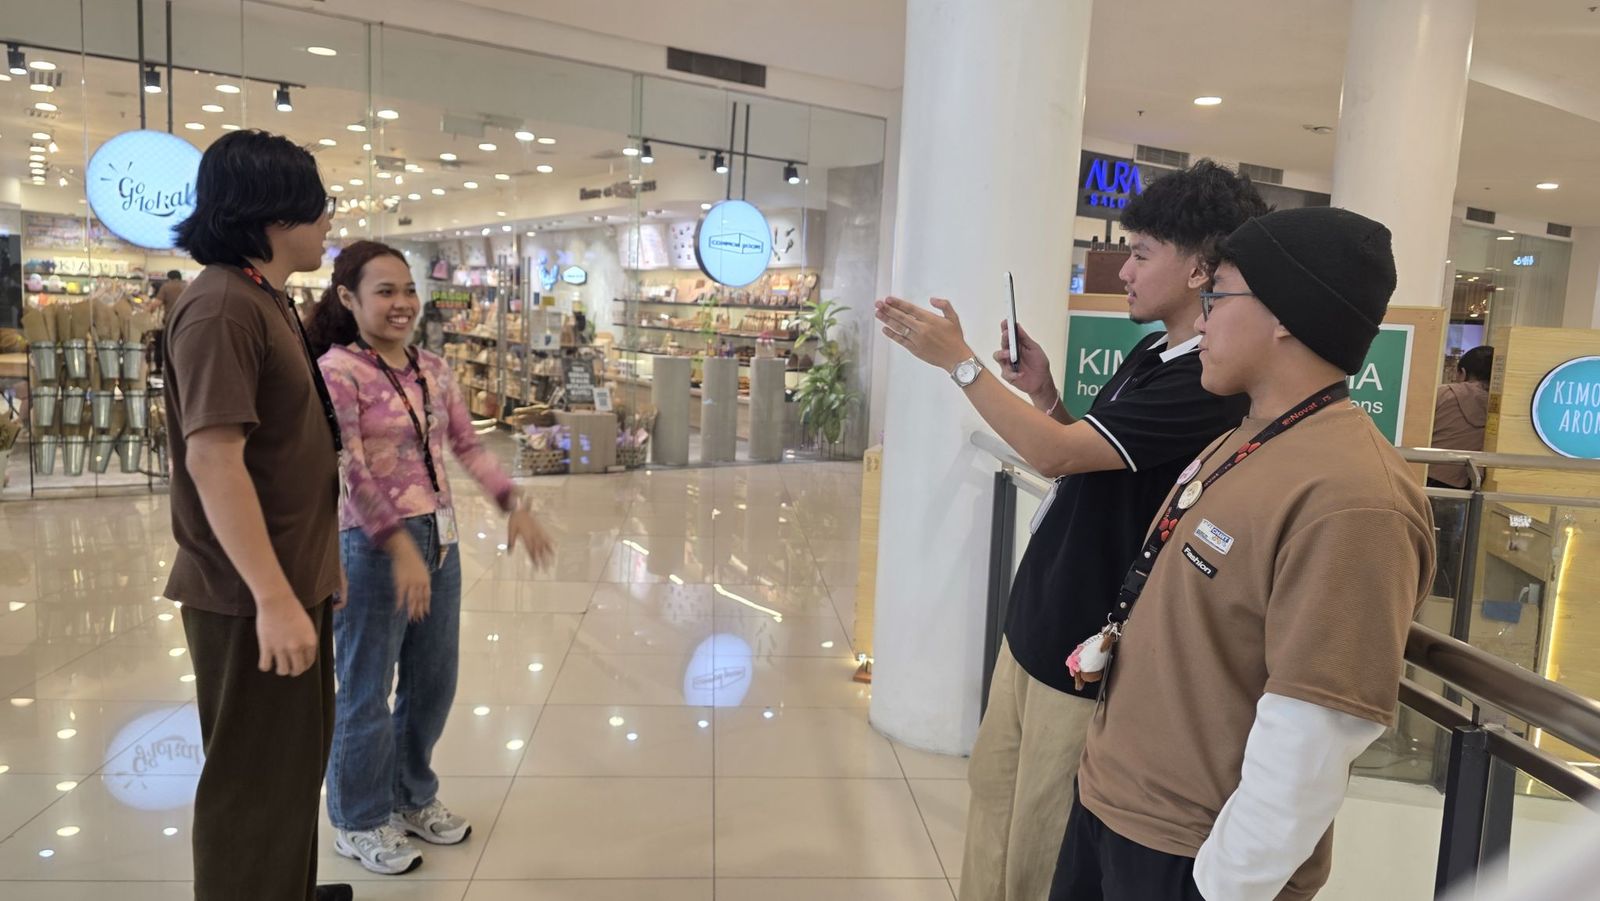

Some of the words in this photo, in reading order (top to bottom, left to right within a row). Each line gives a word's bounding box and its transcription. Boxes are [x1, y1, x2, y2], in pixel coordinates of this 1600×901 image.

[1085, 158, 1143, 196] AURA
[118, 177, 146, 211] Go
[1089, 192, 1131, 209] SALO
[1553, 380, 1600, 407] KIMO
[1184, 547, 1212, 575] Fashion
